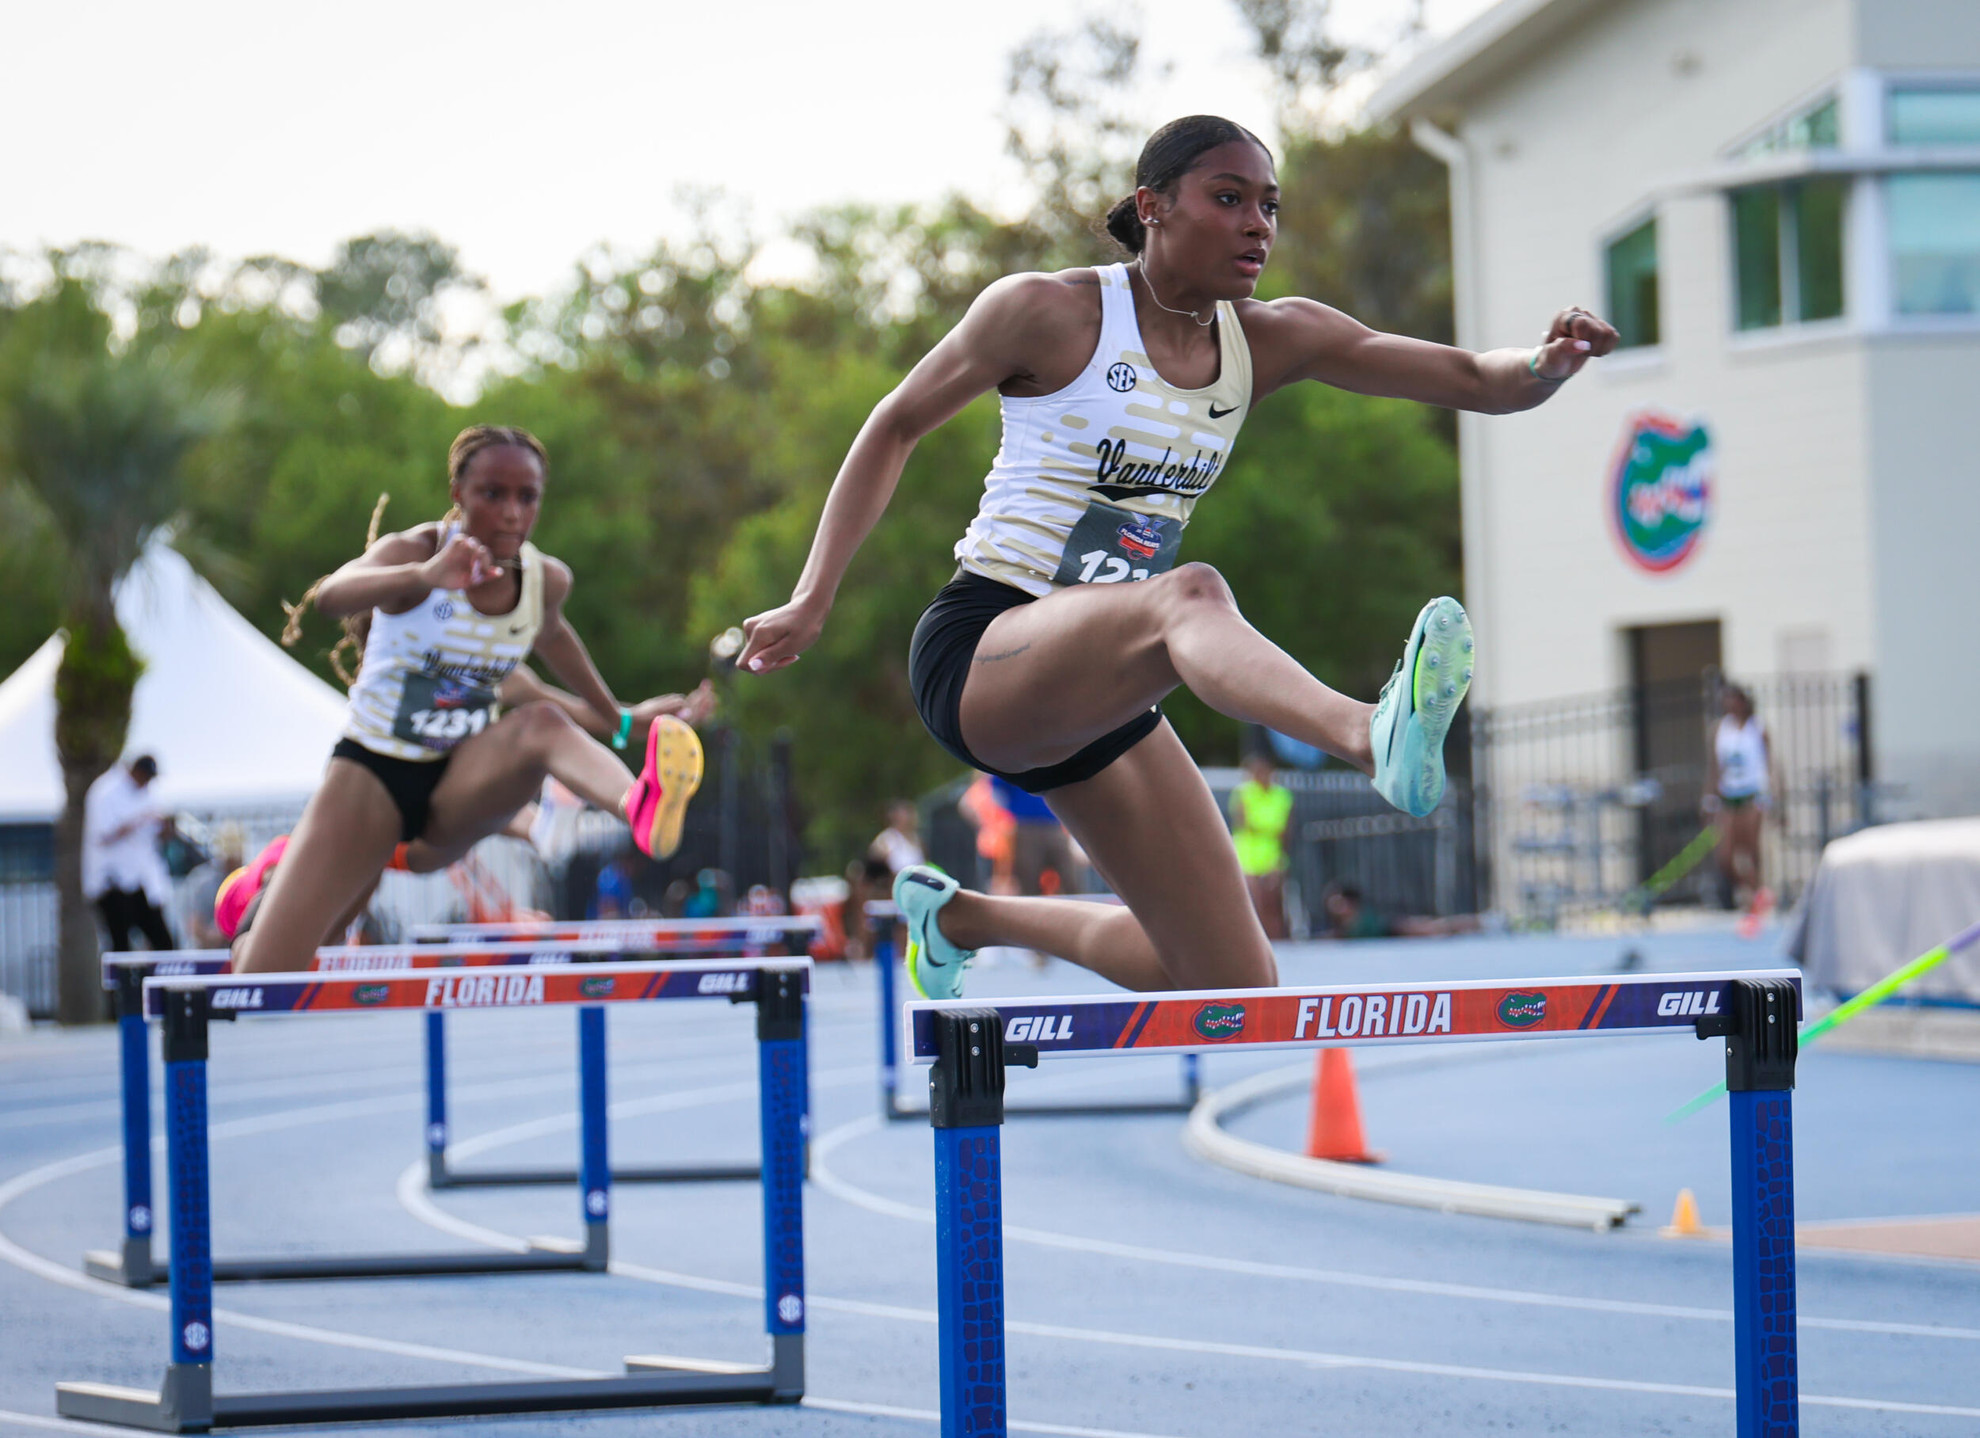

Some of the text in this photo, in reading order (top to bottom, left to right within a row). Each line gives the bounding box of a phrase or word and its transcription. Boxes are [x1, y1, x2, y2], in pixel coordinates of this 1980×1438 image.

[1108, 364, 1136, 391] SEC
[1078, 549, 1161, 584] 12
[410, 708, 488, 739] 1231
[424, 975, 545, 1007] FLORIDA
[698, 972, 750, 994] GILL
[1004, 989, 1721, 1042] GILL FLORIDA GILL
